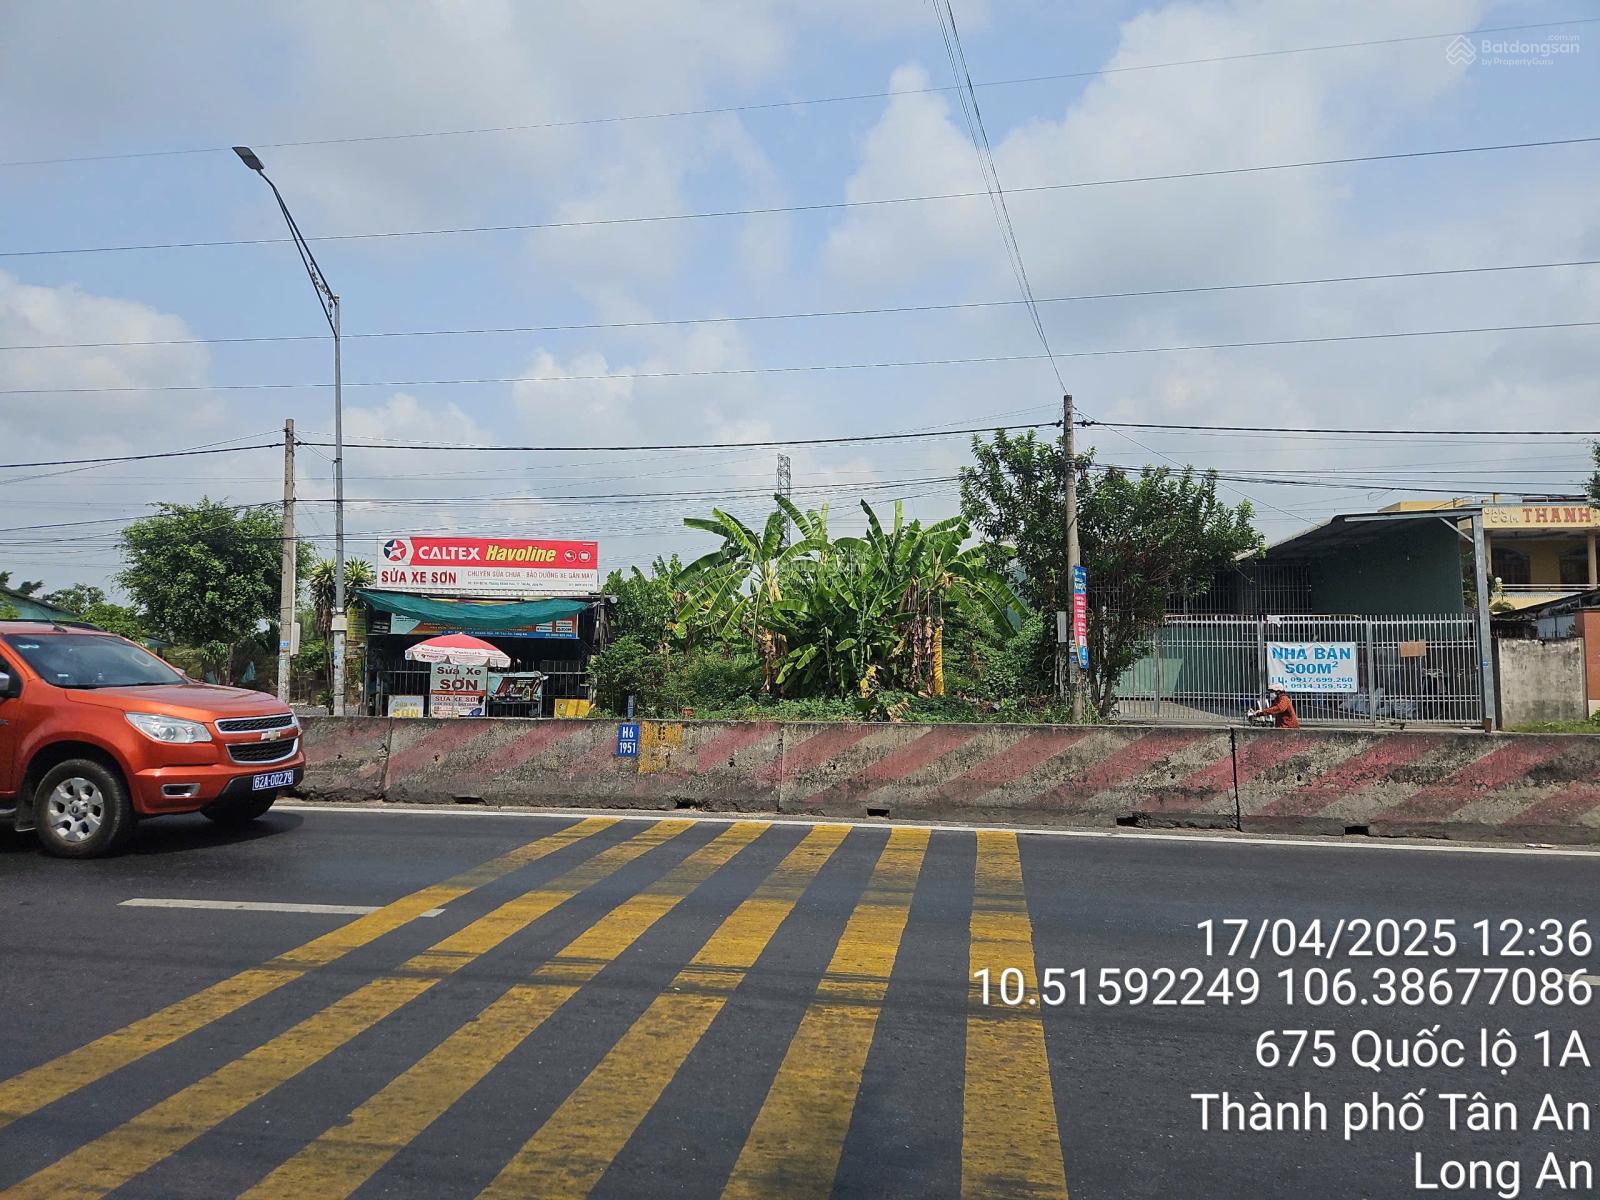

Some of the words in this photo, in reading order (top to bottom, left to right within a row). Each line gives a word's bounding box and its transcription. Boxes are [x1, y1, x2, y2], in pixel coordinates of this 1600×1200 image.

[418, 546, 481, 561] CALTEX
[485, 544, 557, 562] Havoline
[381, 567, 407, 583] SỬA
[411, 571, 427, 583] XE
[431, 569, 457, 584] SƠN
[1271, 644, 1308, 660] NHÀ
[1314, 644, 1351, 660] BÁN
[465, 667, 482, 676] Xe
[439, 676, 478, 691] SƠN
[622, 726, 635, 739] H6
[619, 742, 637, 754] 1951
